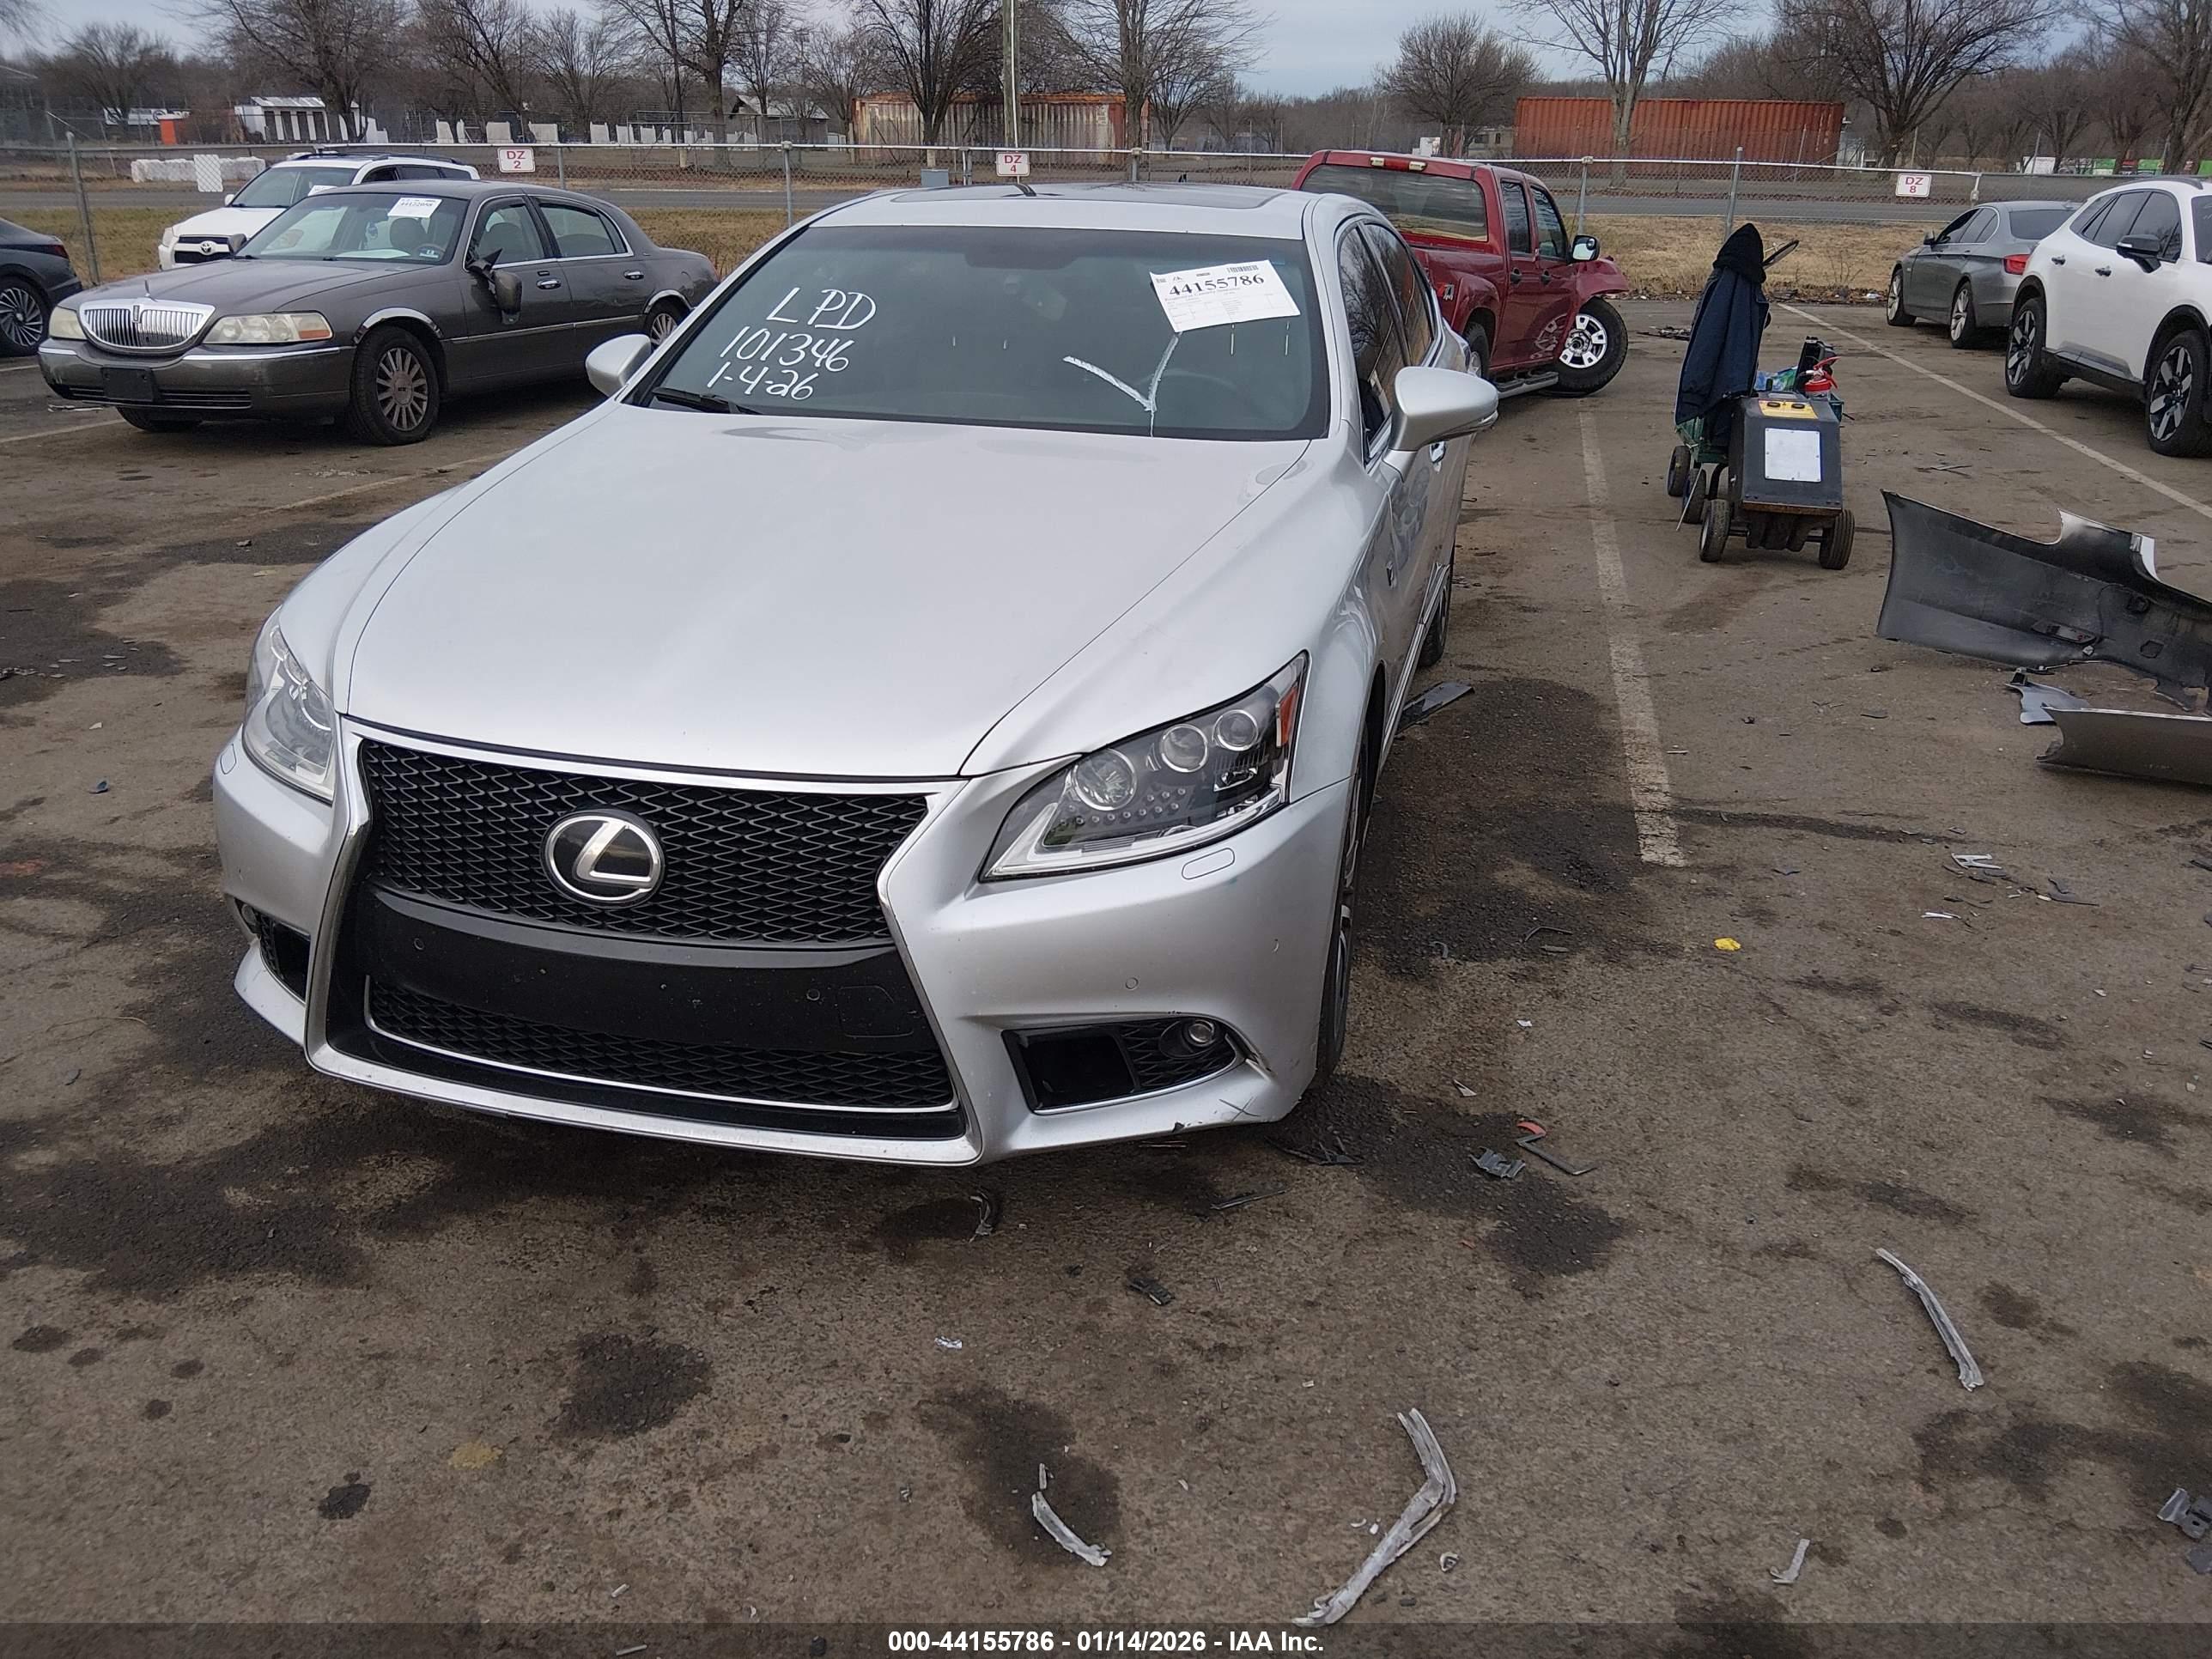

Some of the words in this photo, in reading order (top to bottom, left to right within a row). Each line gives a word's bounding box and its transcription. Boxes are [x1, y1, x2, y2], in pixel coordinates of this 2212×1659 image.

[507, 150, 526, 160] DZ
[1004, 155, 1022, 164] DZ
[514, 160, 521, 169] 2
[1010, 164, 1017, 173] 4
[1905, 177, 1924, 185] DZ
[1169, 273, 1265, 296] 44155786
[720, 325, 854, 372] 101346
[707, 362, 819, 400] 1-4-26
